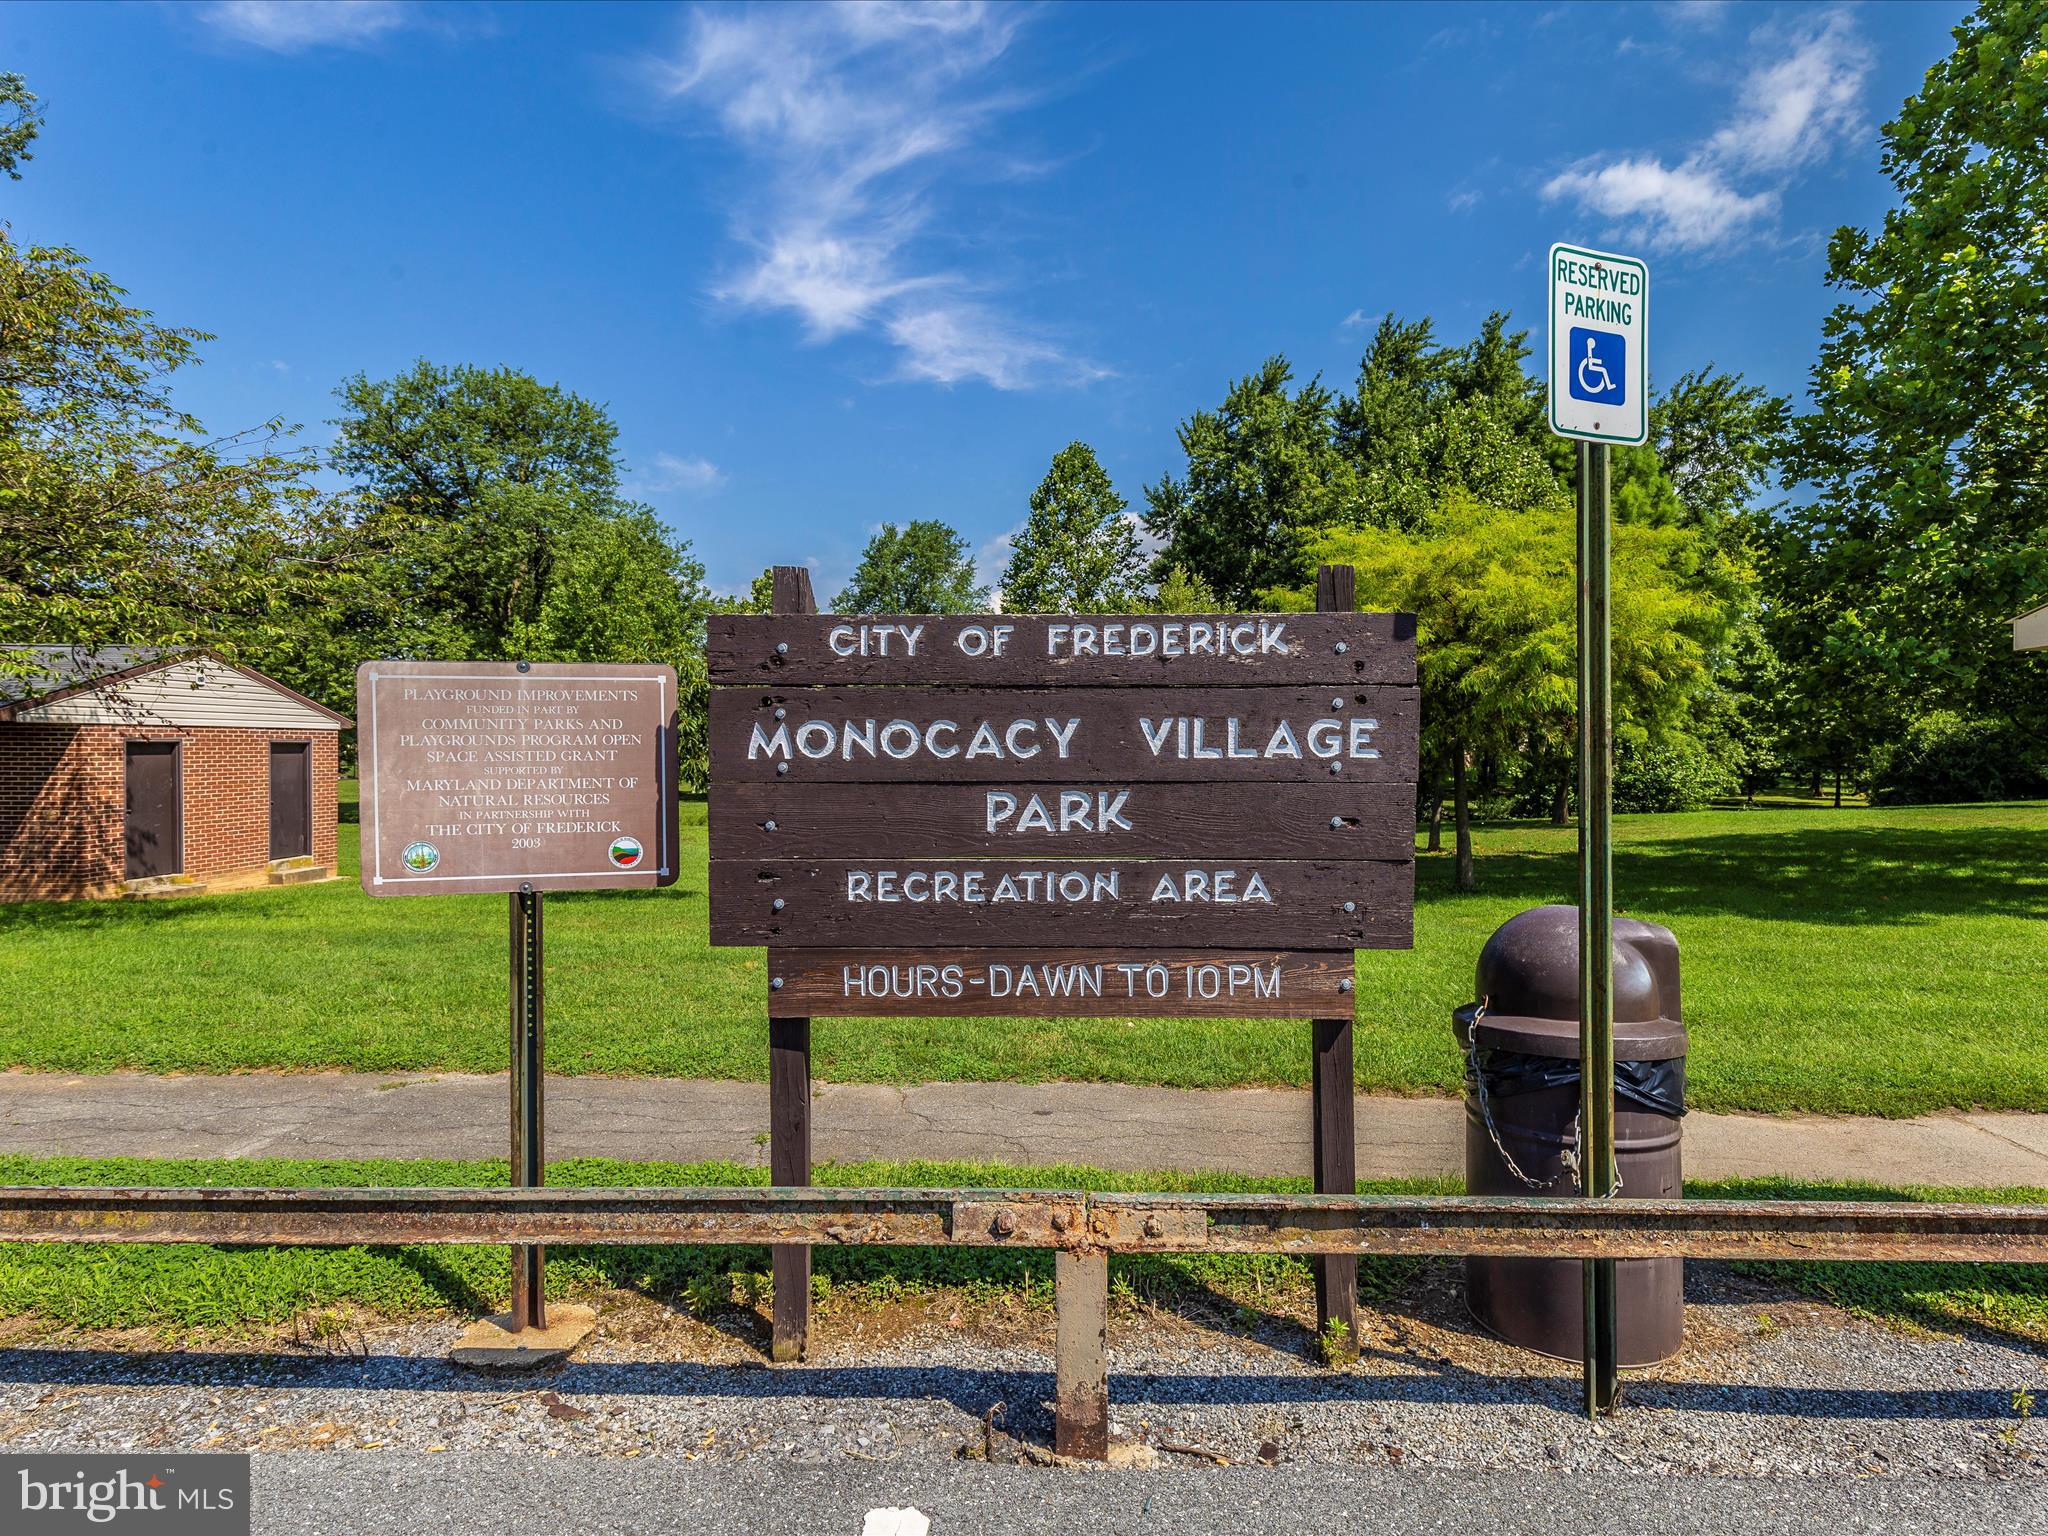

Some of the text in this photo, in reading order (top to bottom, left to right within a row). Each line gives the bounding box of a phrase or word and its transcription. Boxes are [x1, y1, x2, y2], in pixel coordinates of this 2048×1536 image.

[1558, 258, 1639, 296] RESERVED
[1565, 292, 1632, 325] PARKING
[829, 622, 1290, 656] CITY OF FREDERICK
[404, 689, 638, 701] PLAYGROUND IMPROVEMENTS
[467, 705, 579, 714] FUNDED IN PART BY
[422, 718, 623, 730] COMMUNITY PARKS AND
[400, 734, 642, 747] PLAYGROUNDS PROGRAM OPEN
[747, 718, 1379, 760] MONOCACY VILLAGE
[426, 750, 617, 763] SPACE ASSISTED GRANT
[484, 766, 564, 775] SUPPORTED BY
[407, 777, 638, 791] MARYLAND DEPARTMENT OF
[439, 793, 609, 807] NATURAL RESOURCES
[459, 809, 590, 820] IN PARTNERSHIP WITH
[986, 791, 1134, 833] PARK
[426, 821, 621, 836] THE CITY OF FREDERICK
[511, 838, 541, 849] 2003
[847, 870, 1272, 902] RECREATION AREA
[1118, 965, 1169, 998] TO
